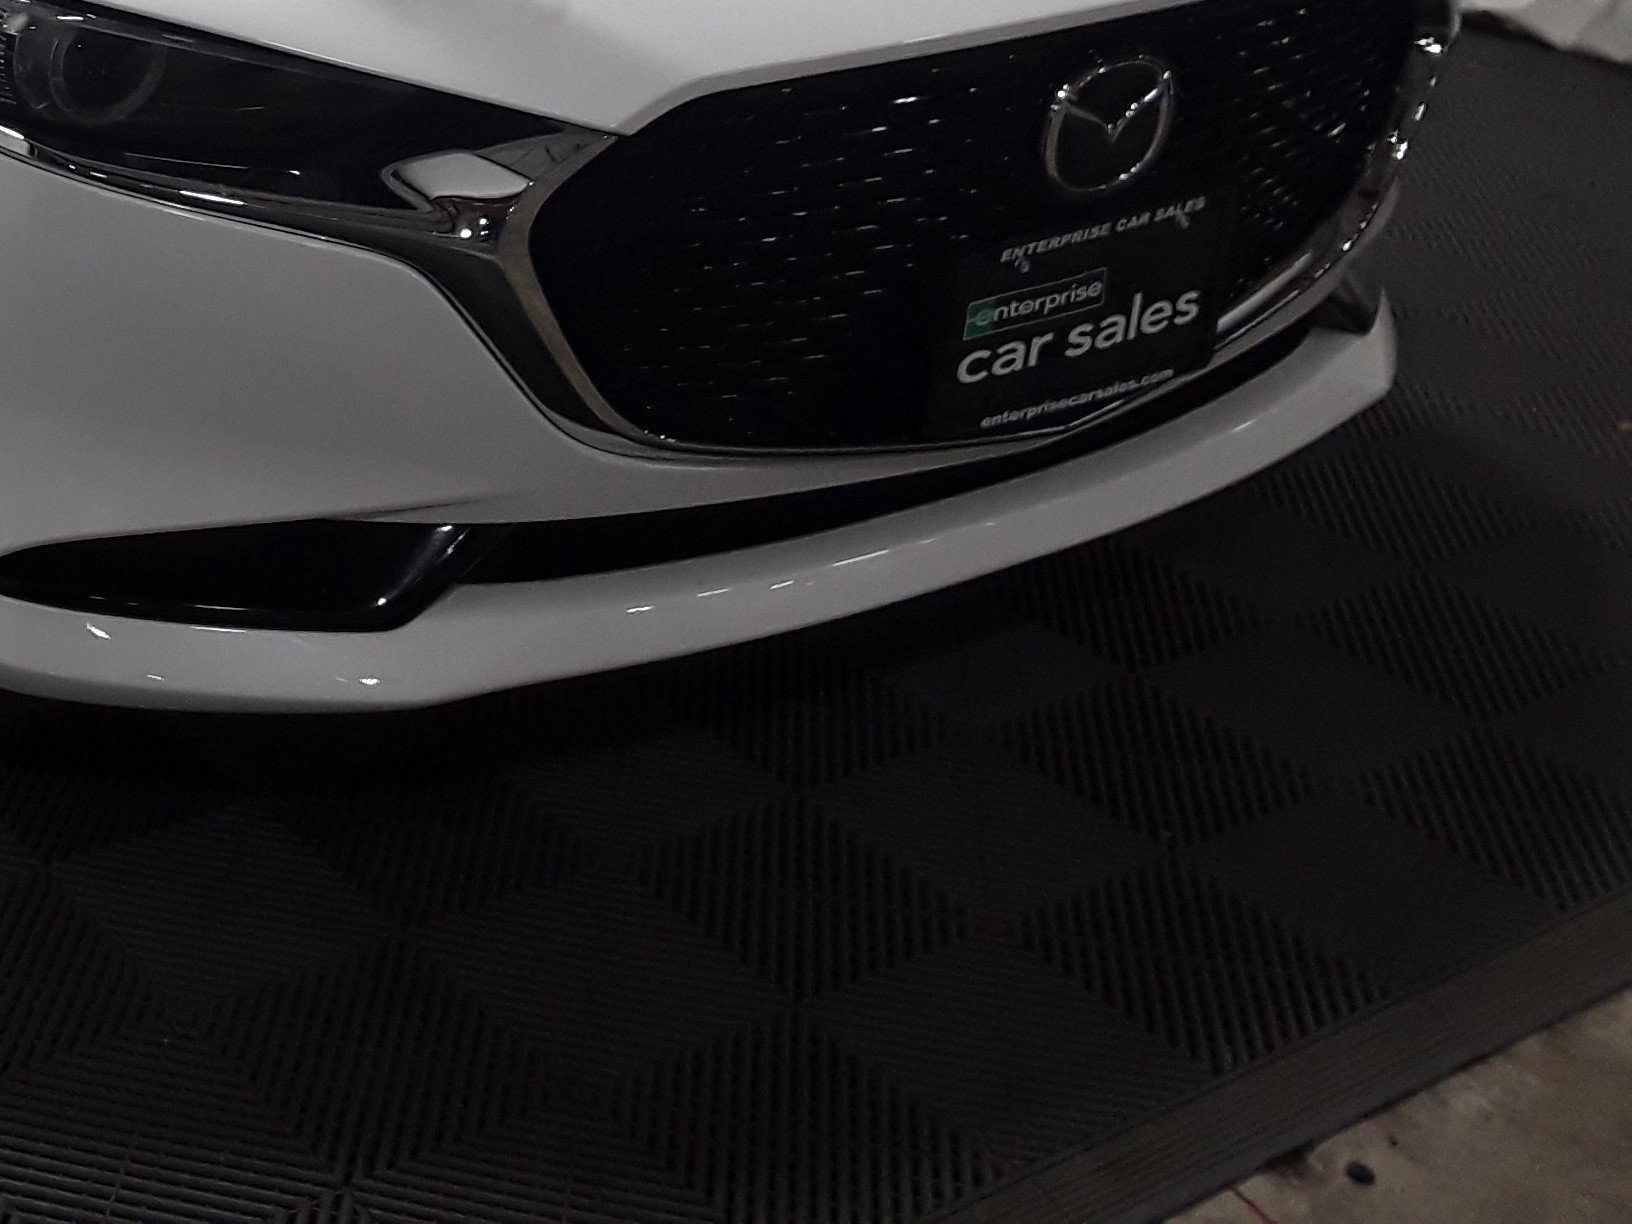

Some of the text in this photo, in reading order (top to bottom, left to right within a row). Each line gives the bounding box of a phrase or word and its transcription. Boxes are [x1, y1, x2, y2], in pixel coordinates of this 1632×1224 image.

[1000, 195, 1206, 263] ENTERPRISE CAR SALES
[974, 279, 1104, 326] enterprise
[956, 289, 1202, 385] car sales
[979, 368, 1175, 429] enterprisecarsales.com
